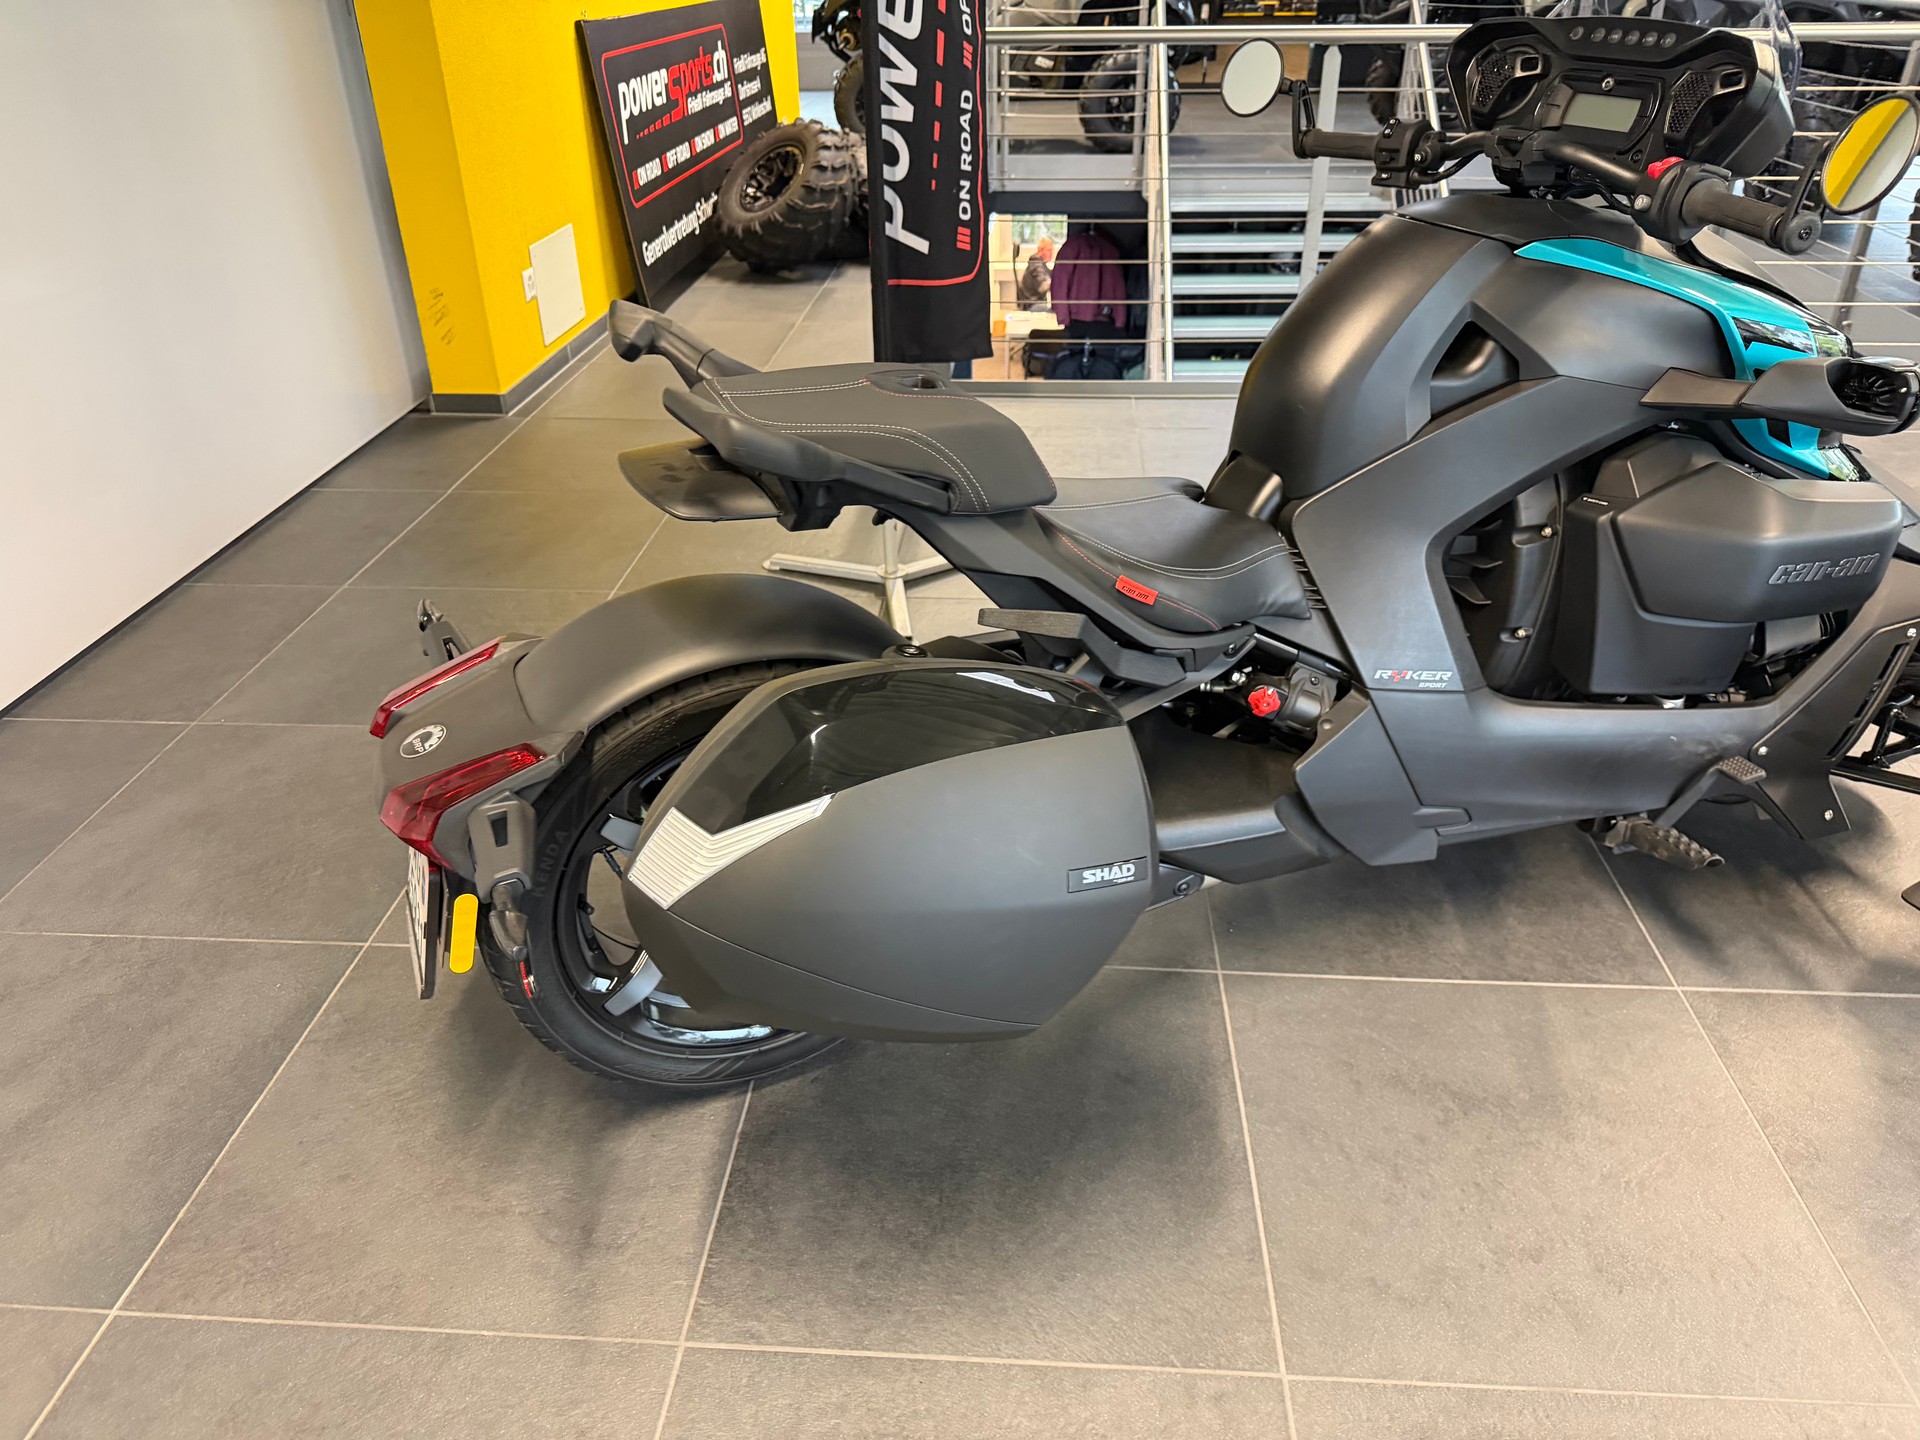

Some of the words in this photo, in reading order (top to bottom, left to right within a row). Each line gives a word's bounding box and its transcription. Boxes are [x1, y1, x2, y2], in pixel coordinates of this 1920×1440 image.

[960, 90, 973, 171] ROAD
[637, 165, 648, 186] ON
[645, 157, 662, 184] ROAD
[666, 149, 678, 169] OFF
[959, 180, 971, 221] ON
[1374, 669, 1453, 682] RYKER
[412, 737, 425, 753] BRP
[1082, 863, 1136, 884] SHAD
